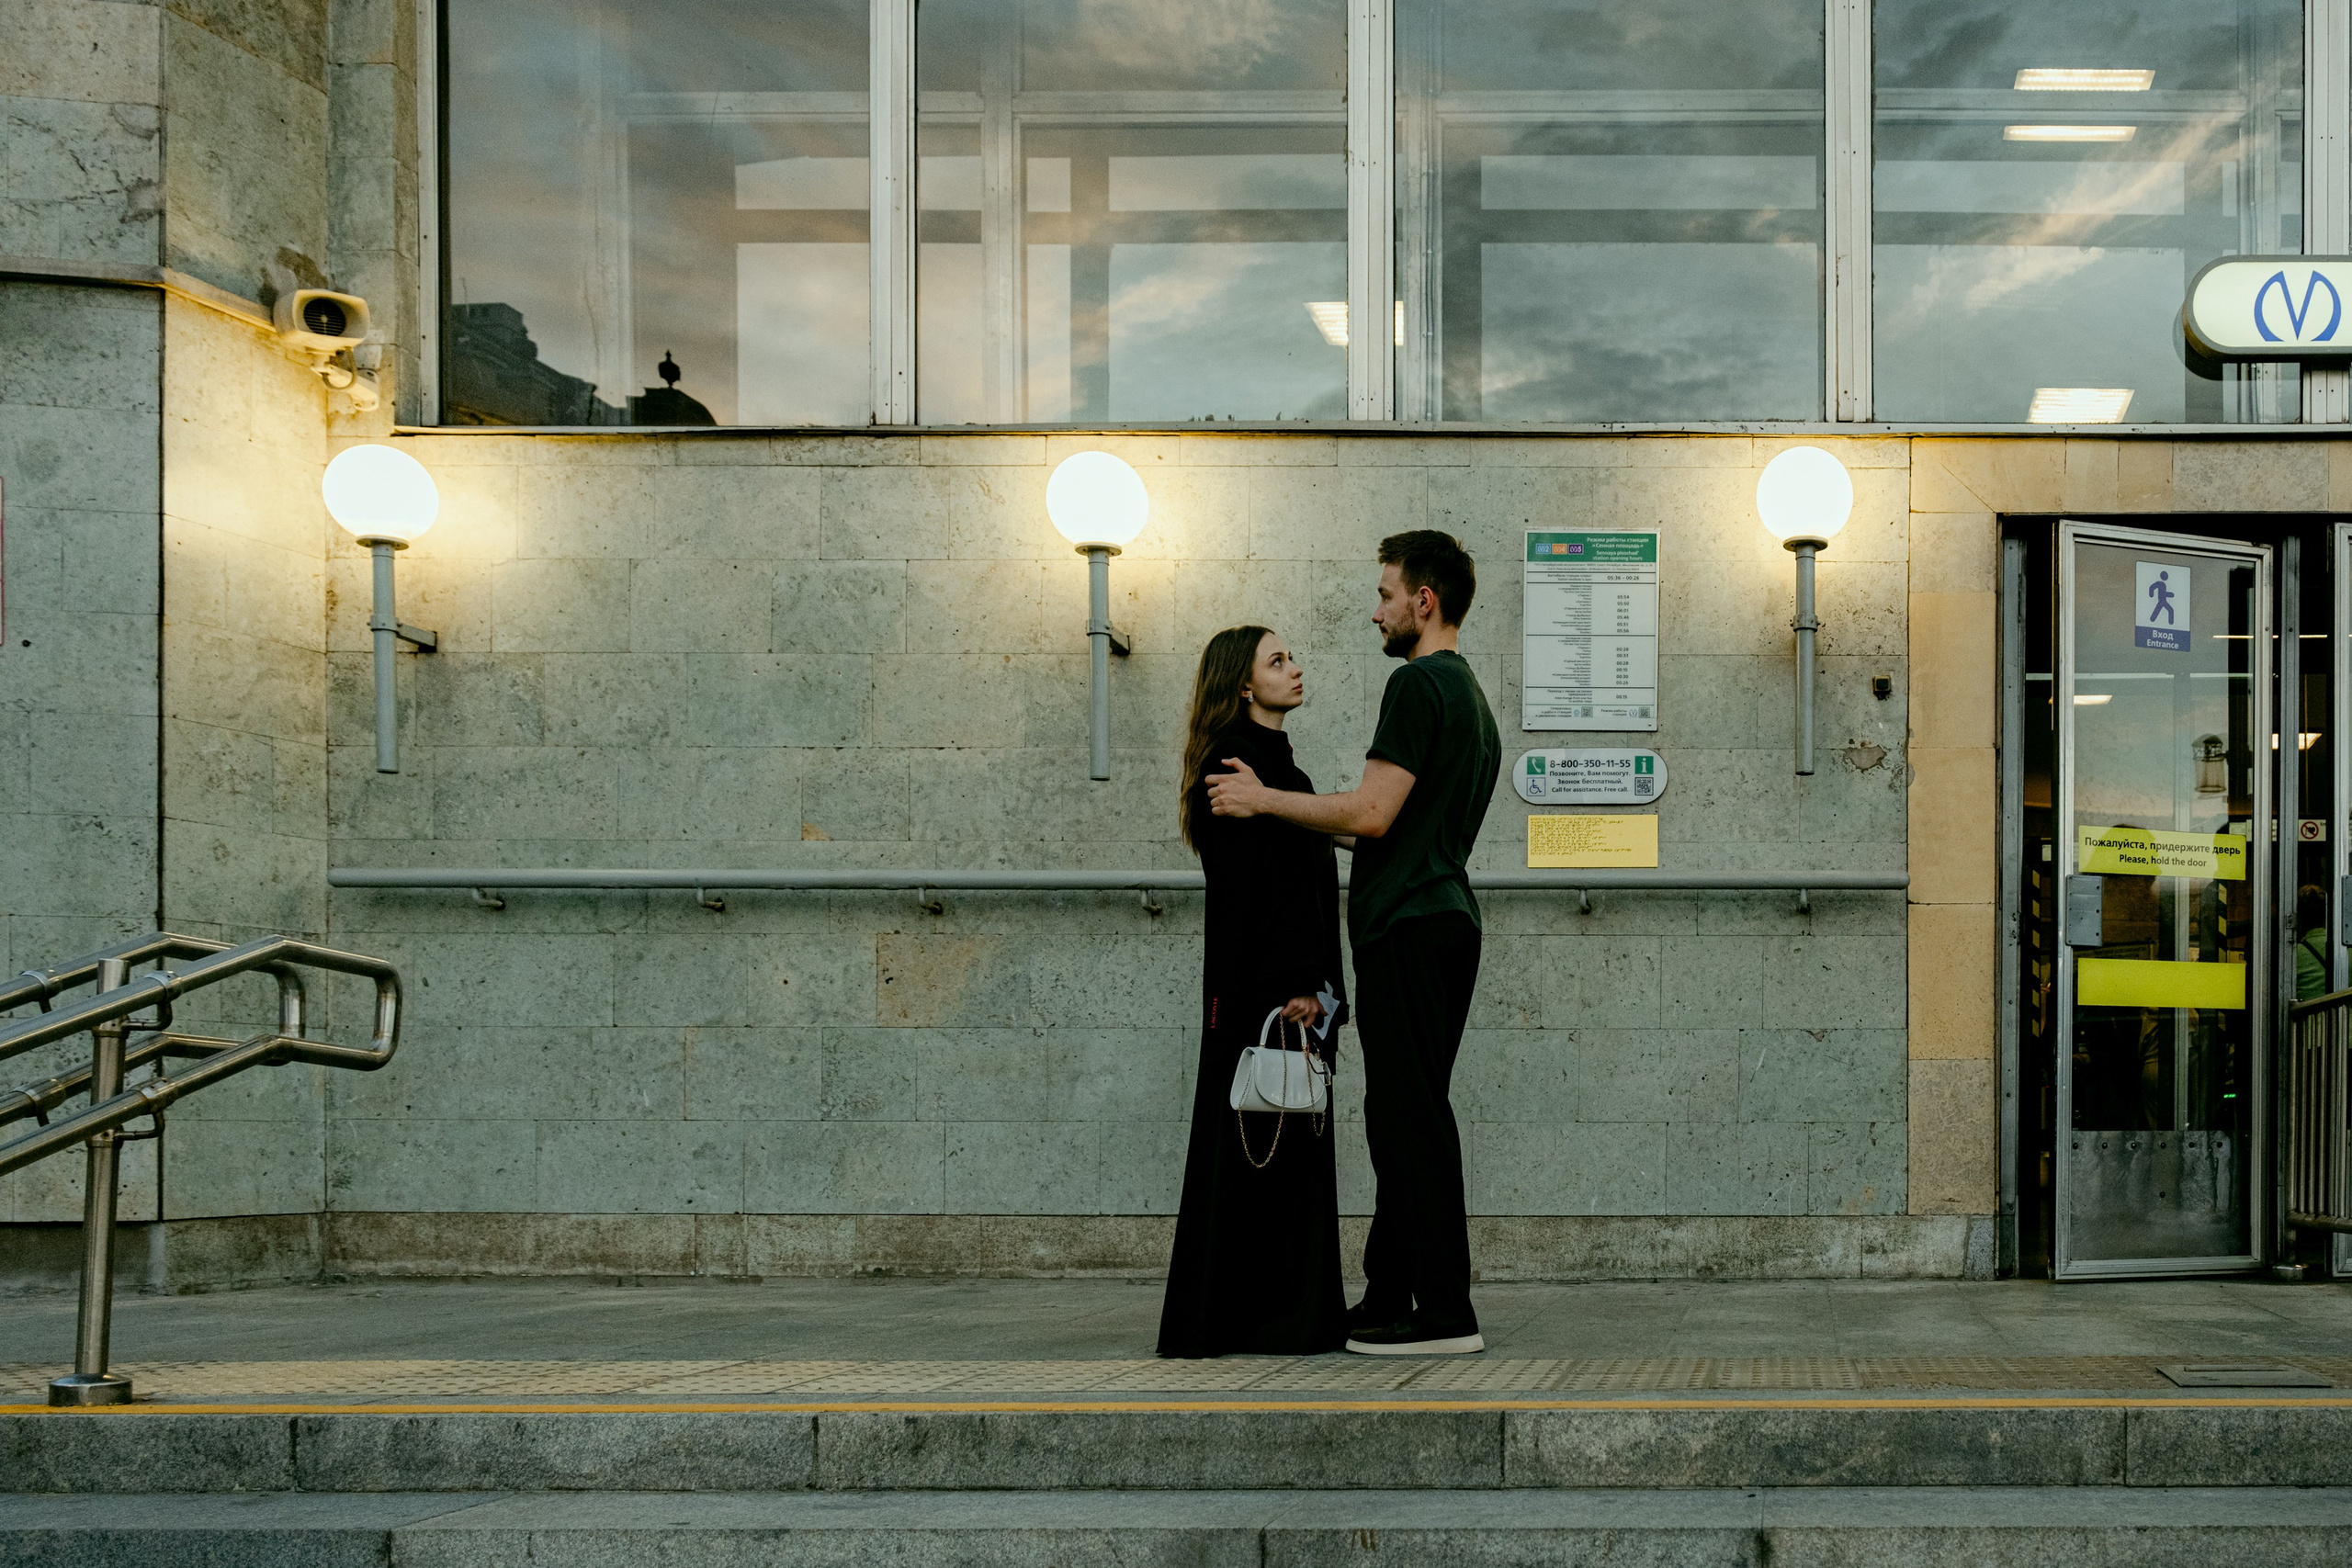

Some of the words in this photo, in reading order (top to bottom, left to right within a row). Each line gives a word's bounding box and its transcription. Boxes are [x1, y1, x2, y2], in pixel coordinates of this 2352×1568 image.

[2153, 630, 2174, 640] Вход
[2146, 639, 2179, 649] Entrance
[1550, 760, 1631, 768] 8-800-350-11-55
[2085, 837, 2148, 851] Пожалуйста,
[2150, 842, 2211, 853] придержите
[2212, 846, 2241, 856] дверь
[2119, 854, 2149, 865] Please,
[2151, 855, 2169, 865] hold
[2171, 857, 2186, 866] the
[2188, 858, 2207, 867] door
[1210, 997, 1218, 1029] LACOSTE
